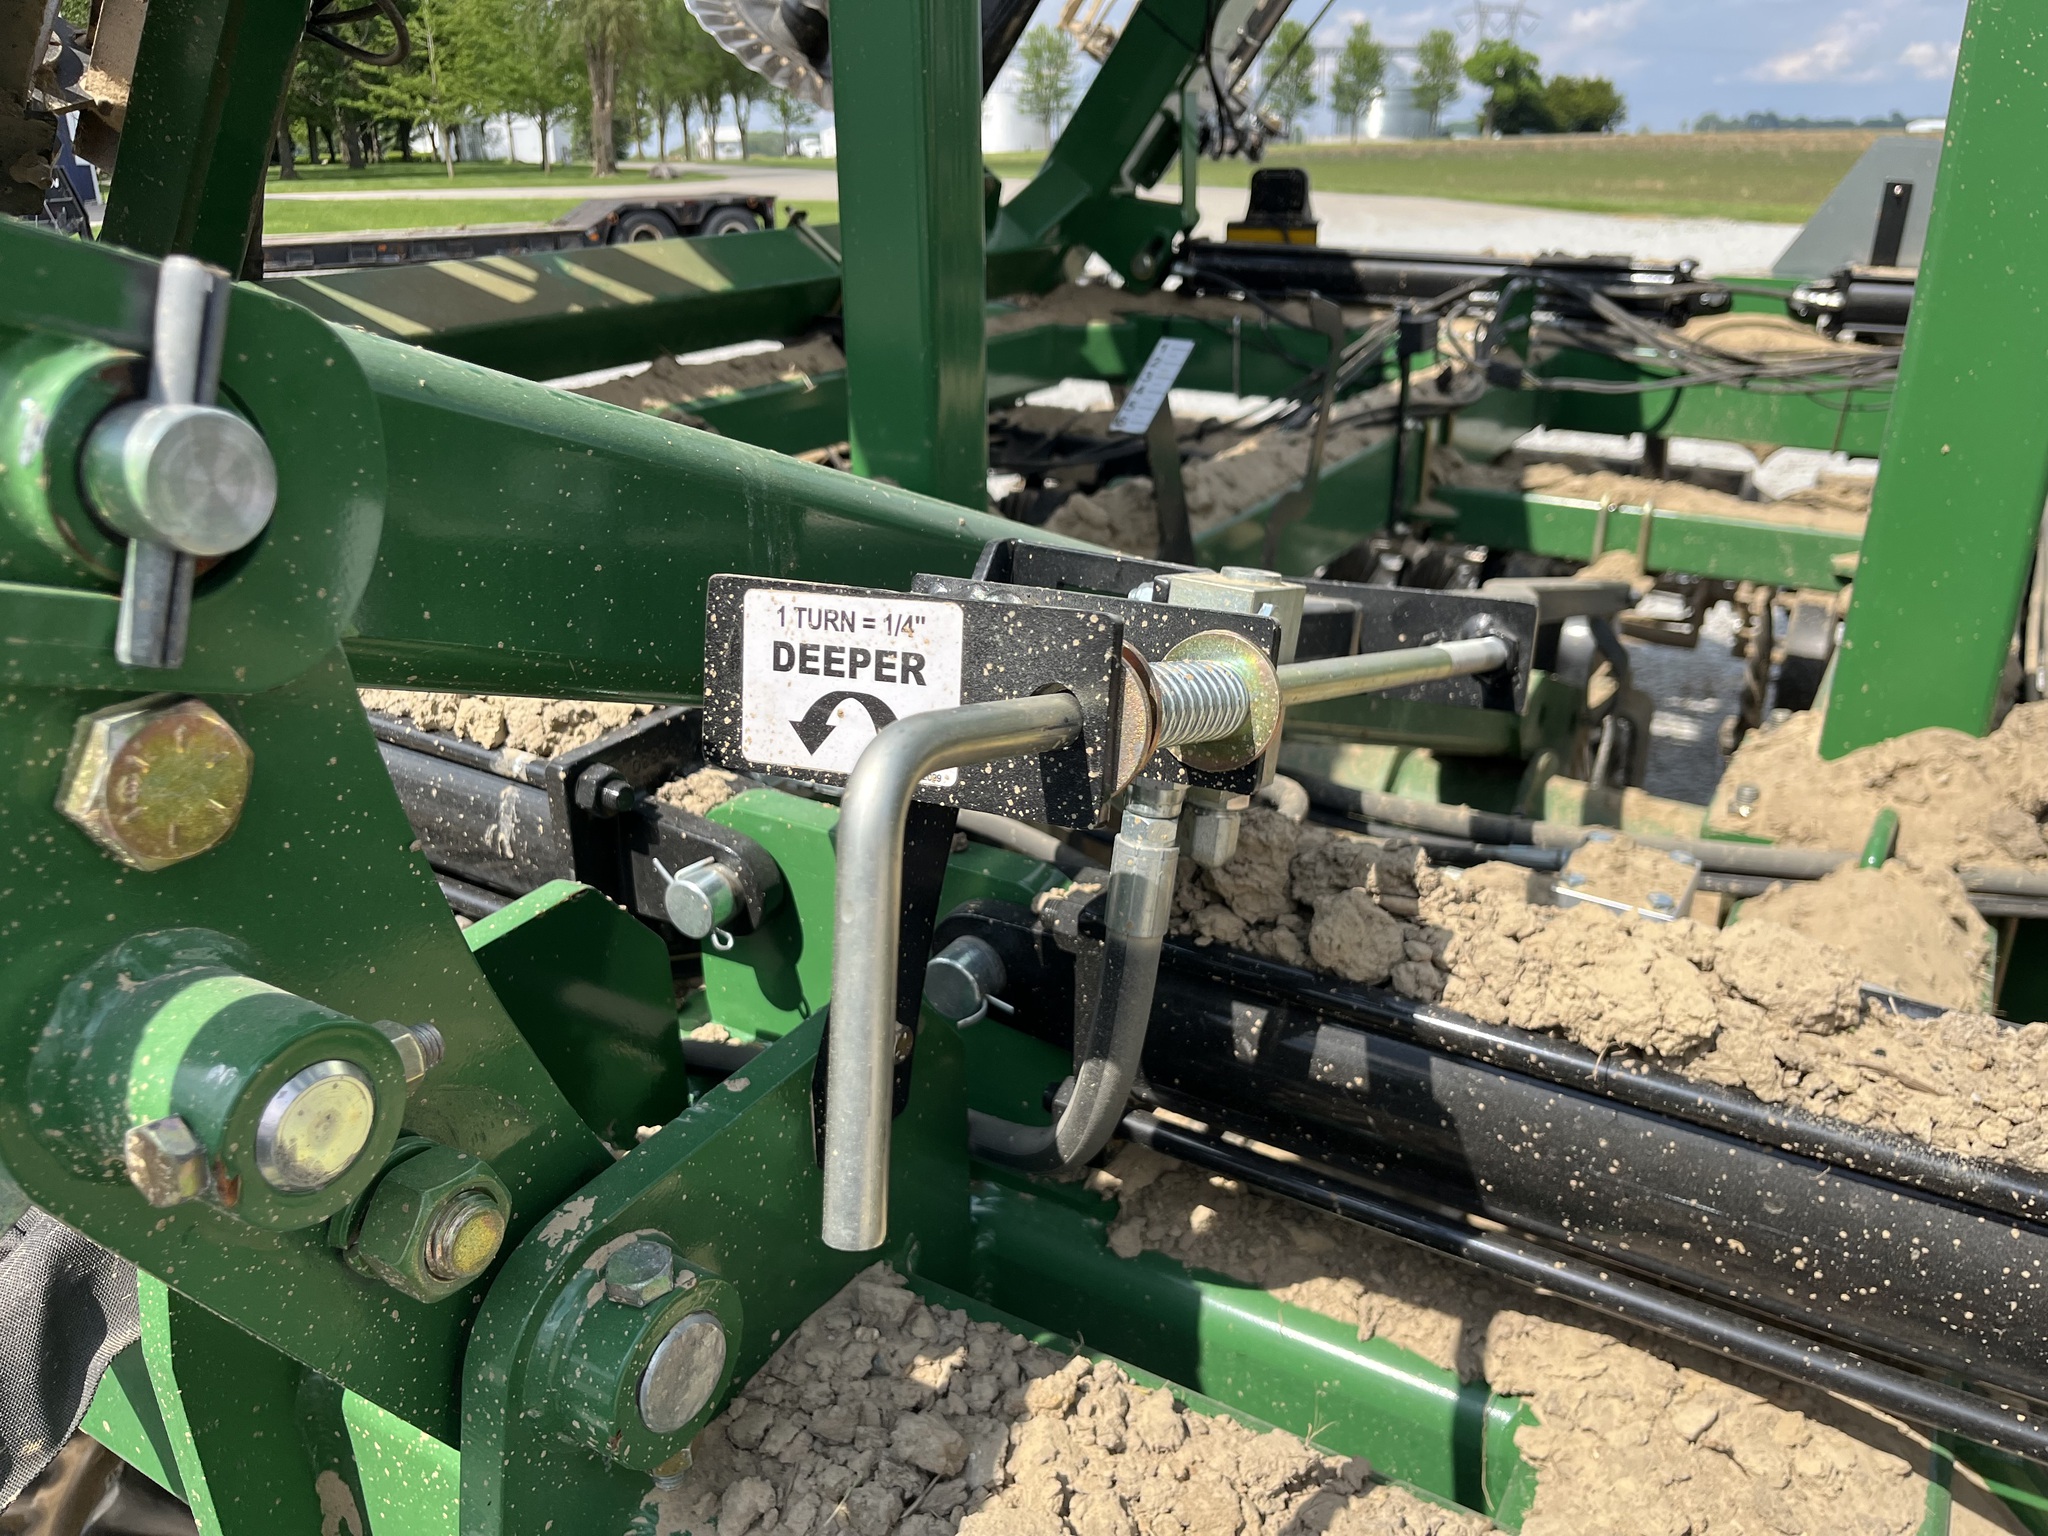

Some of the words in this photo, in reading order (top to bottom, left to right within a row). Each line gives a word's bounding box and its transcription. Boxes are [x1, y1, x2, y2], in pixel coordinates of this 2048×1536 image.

[1150, 356, 1163, 368] 2
[1141, 370, 1154, 383] 3
[777, 605, 785, 627] 1
[794, 606, 855, 633] TURN
[862, 617, 876, 629] =
[883, 613, 926, 638] 1/4"
[773, 640, 927, 686] DEEPER
